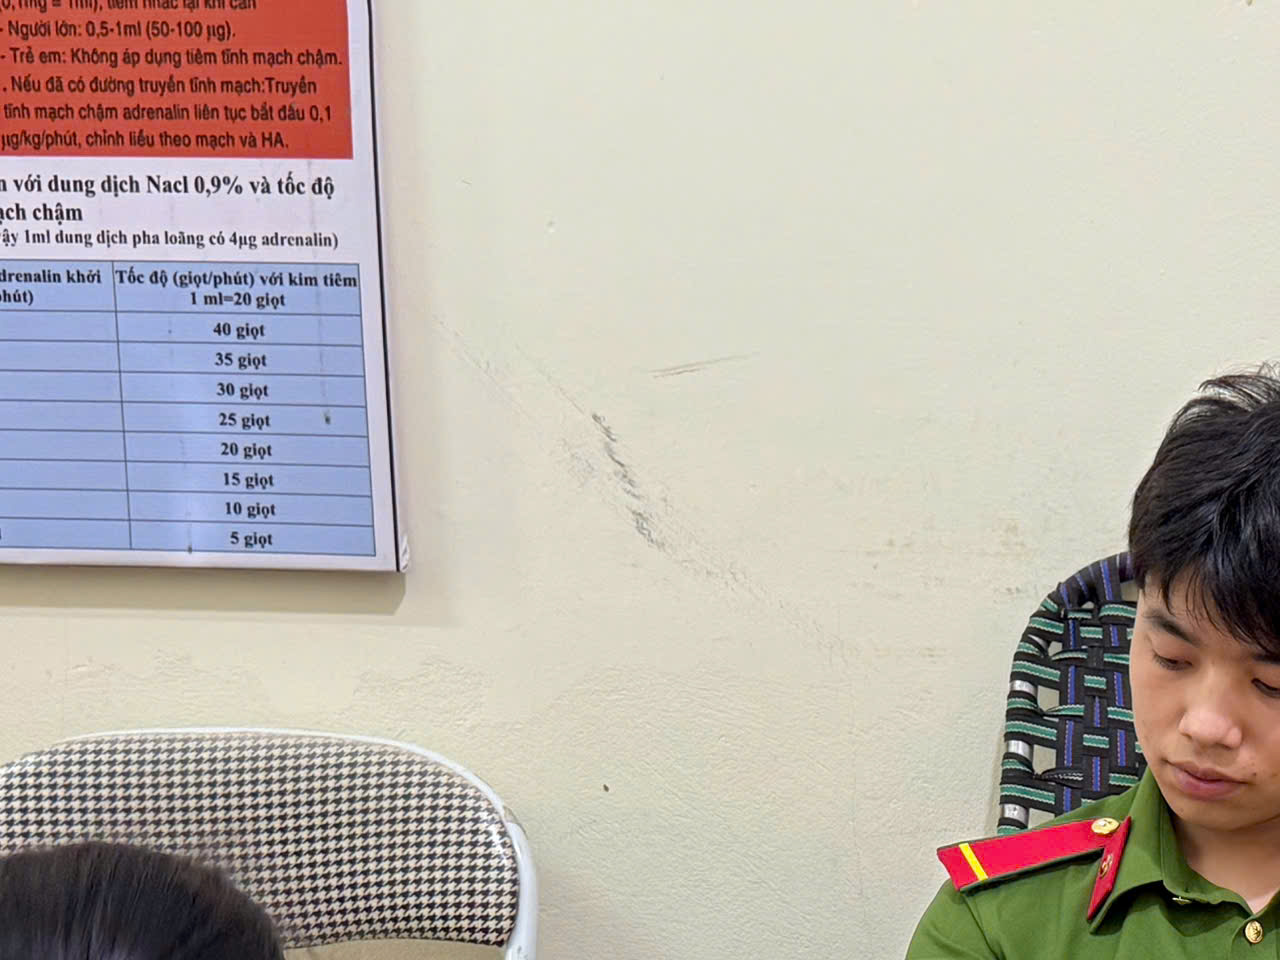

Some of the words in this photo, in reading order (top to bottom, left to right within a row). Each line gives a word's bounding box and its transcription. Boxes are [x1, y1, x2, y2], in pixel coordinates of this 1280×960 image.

[0, 0, 47, 13] 0,1mg
[8, 20, 50, 40] Người
[55, 20, 82, 37] lớn:
[86, 20, 141, 38] 0,5-1ml
[146, 20, 202, 40] (50-100
[9, 46, 34, 64] Trẻ
[39, 51, 66, 64] em:
[71, 48, 118, 68] Không
[123, 48, 140, 67] áp
[145, 49, 181, 68] dụng
[186, 48, 217, 65] tiêm
[221, 49, 248, 65] tĩnh
[253, 48, 293, 67] mạch
[297, 49, 343, 68] chậm.
[11, 74, 41, 92] Nếu
[46, 76, 63, 92] đã
[68, 76, 85, 92] có
[89, 75, 134, 97] đường
[190, 76, 216, 93] tĩnh
[4, 103, 30, 119] tĩnh
[34, 104, 74, 122] mạch
[78, 103, 118, 122] chậm
[123, 104, 190, 120] adrenalin
[194, 104, 220, 121] liên
[224, 105, 247, 123] tục
[309, 105, 331, 123] 0,1
[86, 129, 124, 146] chỉnh
[159, 131, 191, 147] theo
[196, 131, 235, 150] mạch
[239, 132, 257, 148] và
[261, 131, 289, 148] HA.
[13, 174, 42, 192] với
[48, 175, 95, 197] dung
[101, 175, 140, 197] dịch
[146, 175, 189, 193] Nacl
[194, 175, 243, 197] 0,9%
[249, 176, 271, 194] và
[277, 171, 305, 195] tốc
[311, 176, 334, 200] độ
[32, 202, 83, 225] chậm
[0, 228, 18, 247] ậy
[25, 229, 50, 243] 1ml
[55, 229, 93, 247] dung
[97, 230, 127, 248] dịch
[133, 230, 160, 248] pha
[165, 230, 205, 248] loãng
[209, 231, 225, 245] có
[261, 232, 338, 250] adrenalin)
[66, 269, 101, 284] khởi
[115, 265, 145, 284] Tốc
[149, 270, 168, 288] độ
[173, 270, 255, 289] (giọt/phút)
[260, 272, 284, 286] với
[288, 272, 318, 287] kim
[323, 273, 357, 287] tiêm
[0, 289, 34, 306] hút)
[191, 292, 197, 305] 1
[203, 292, 251, 306] ml=20
[256, 292, 285, 309] giọt
[213, 322, 231, 336] 40
[236, 322, 265, 340] giọt
[214, 352, 233, 366] 35
[238, 353, 267, 370] giọt
[216, 382, 235, 396] 30
[240, 383, 269, 400] giọt
[219, 412, 237, 426] 25
[241, 413, 270, 430] giọt
[221, 442, 239, 456] 20
[243, 443, 272, 460] giọt
[223, 472, 240, 486] 15
[245, 473, 274, 490] giọt
[225, 502, 242, 515] 10
[247, 502, 276, 519] giọt
[230, 531, 239, 545] 5
[244, 532, 272, 549] giọt
